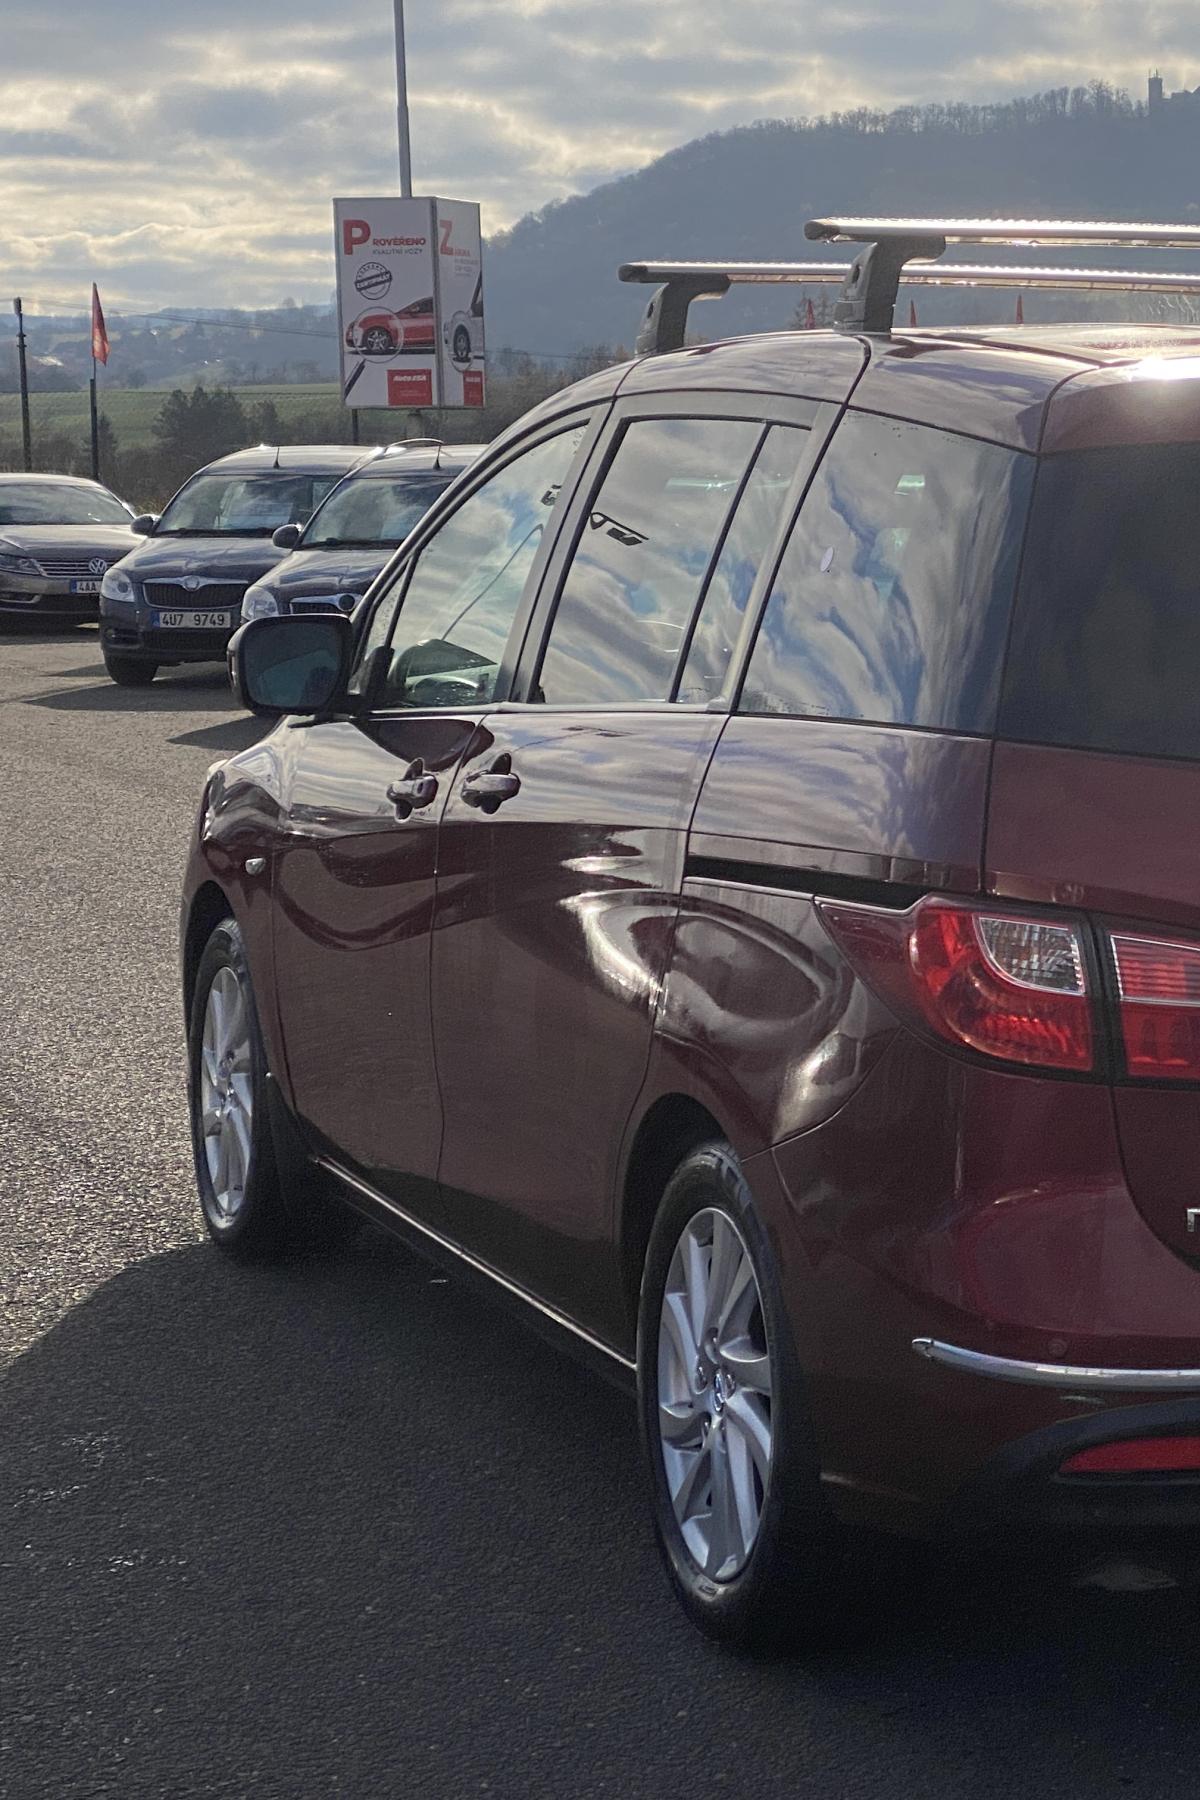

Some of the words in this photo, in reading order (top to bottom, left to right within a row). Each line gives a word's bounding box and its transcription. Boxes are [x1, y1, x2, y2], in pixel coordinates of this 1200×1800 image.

[78, 582, 97, 592] 4AA
[162, 613, 184, 626] 4U7
[193, 613, 225, 626] 9749
